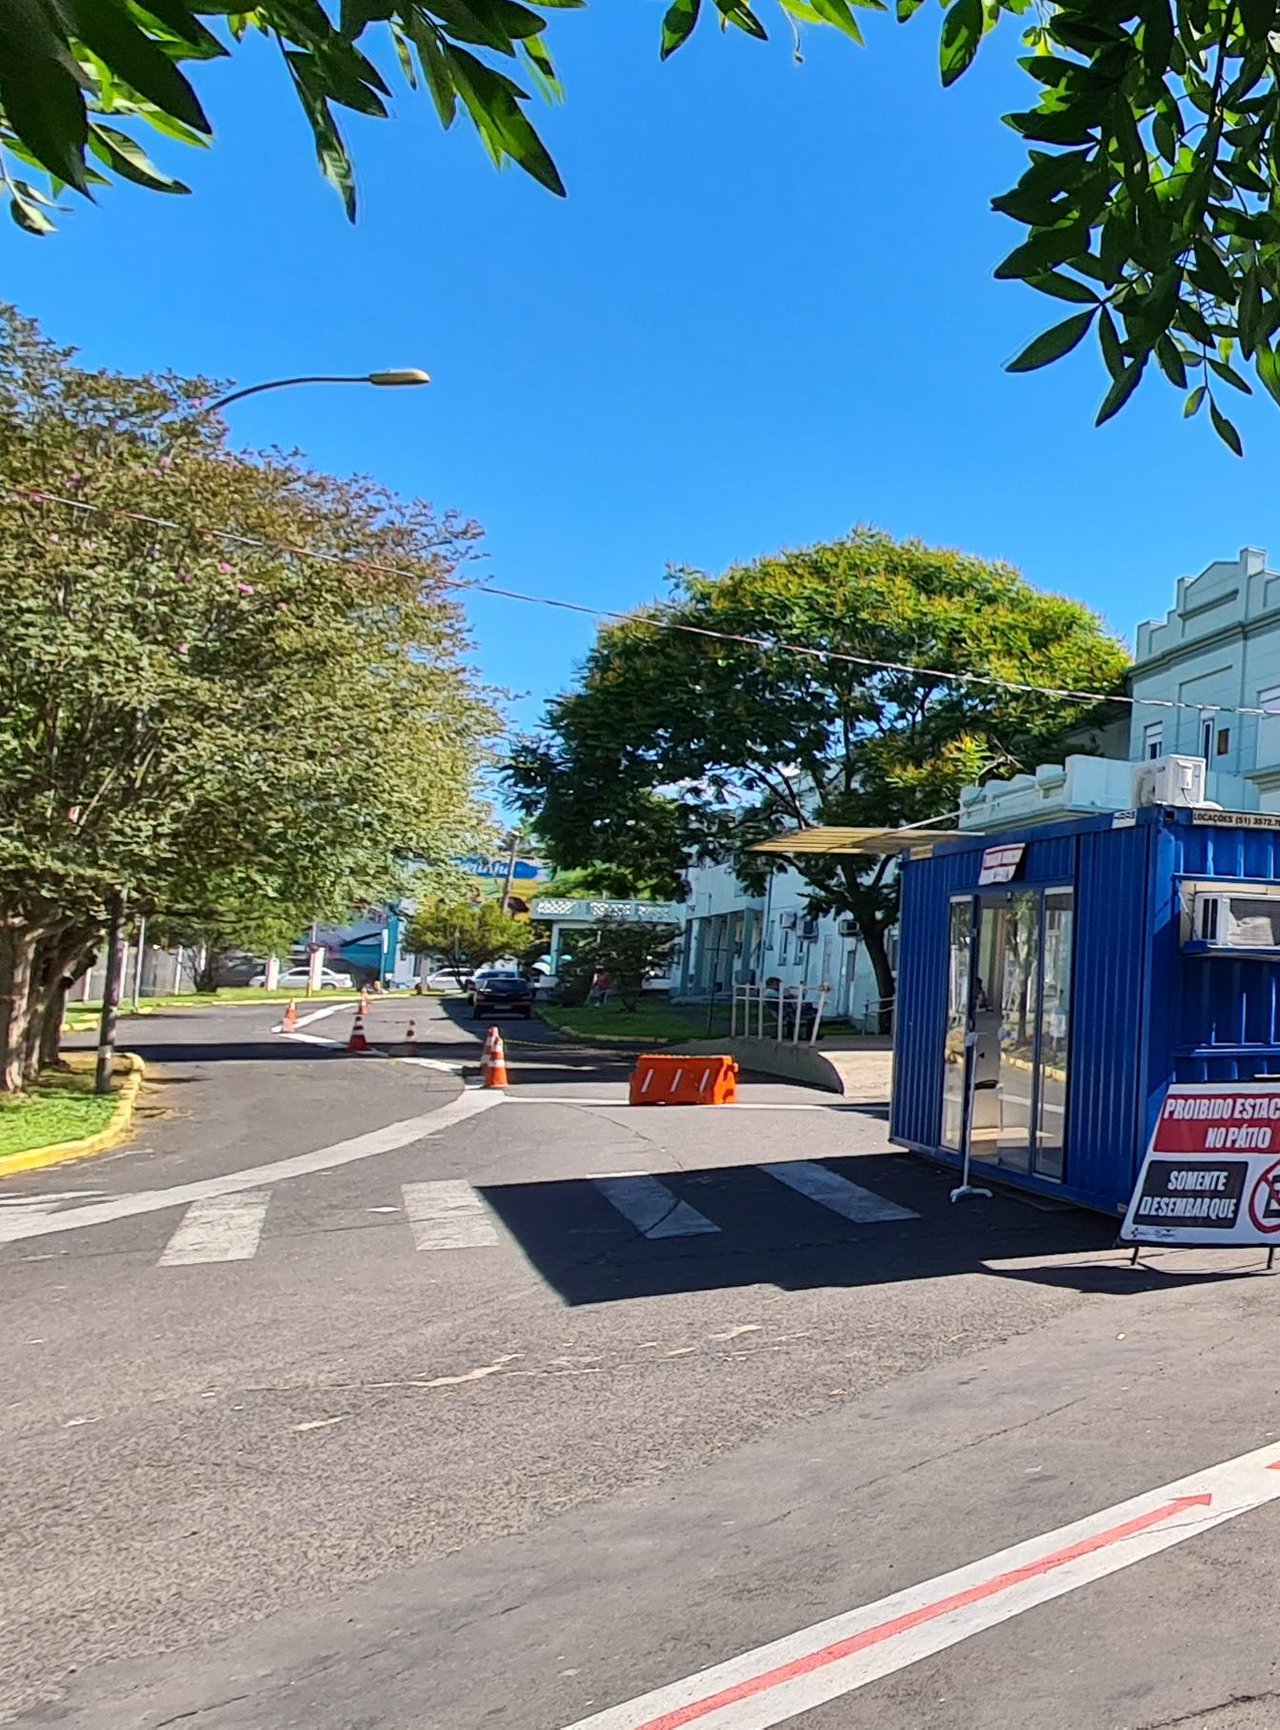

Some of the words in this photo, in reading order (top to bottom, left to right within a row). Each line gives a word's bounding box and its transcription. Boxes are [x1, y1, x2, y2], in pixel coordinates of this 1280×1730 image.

[1194, 813, 1233, 824] LOCAÇÕES
[1235, 817, 1251, 826] (51)
[1163, 1099, 1233, 1120] PROIBIDO
[1205, 1127, 1225, 1148] NO
[1225, 1125, 1272, 1148] PÁTIO
[1167, 1171, 1228, 1191] SOMENTE
[1139, 1197, 1236, 1219] DESEMBARQUE
